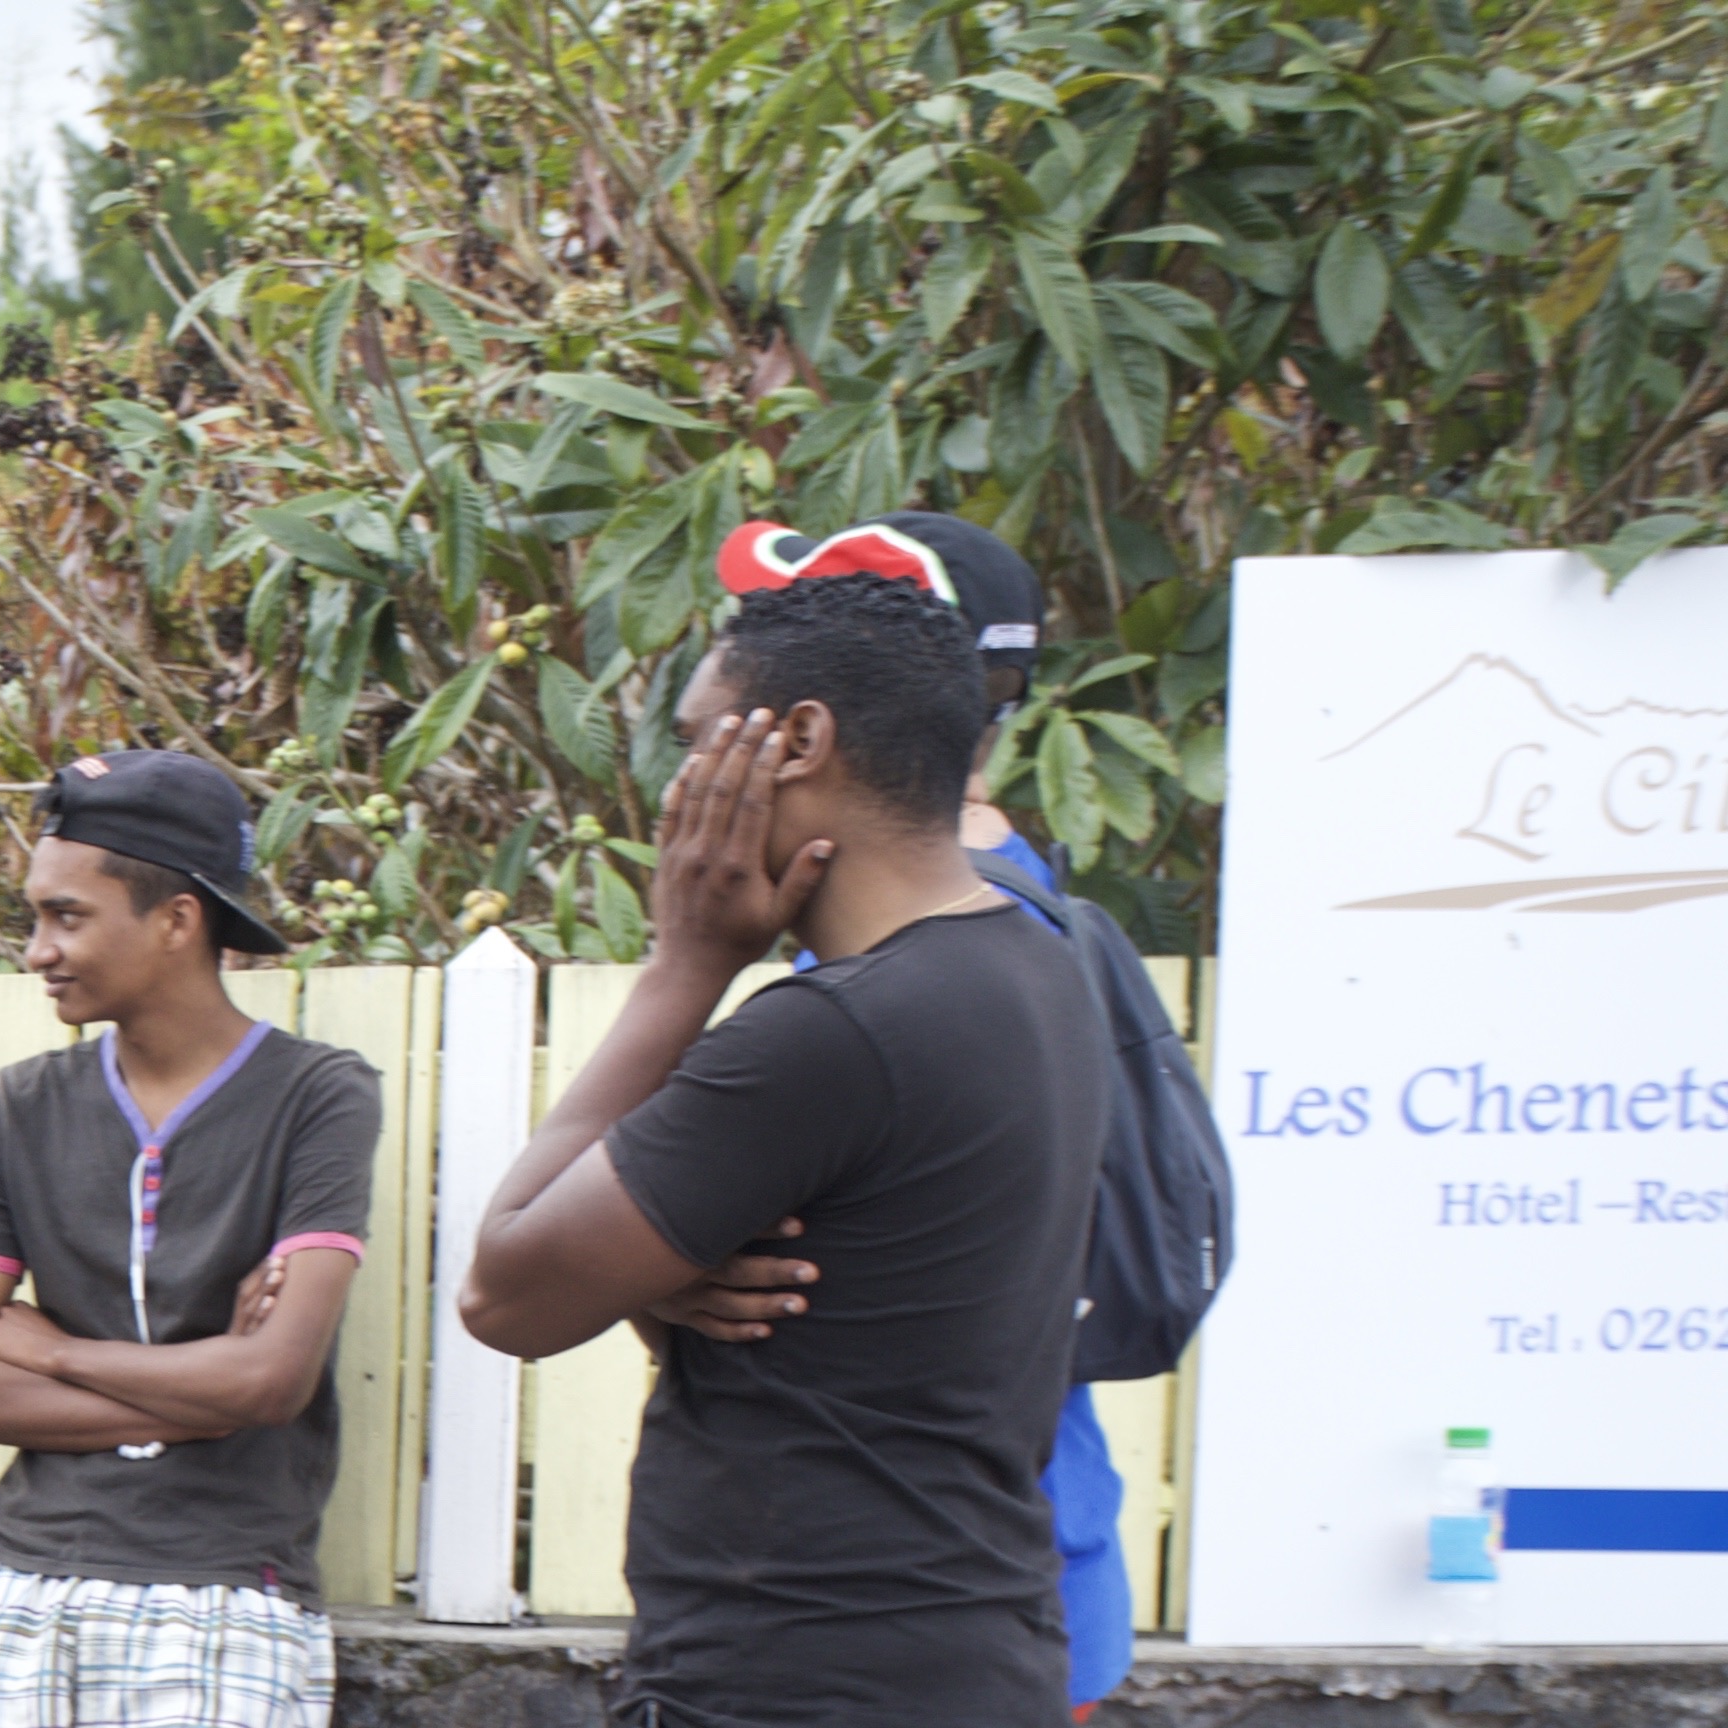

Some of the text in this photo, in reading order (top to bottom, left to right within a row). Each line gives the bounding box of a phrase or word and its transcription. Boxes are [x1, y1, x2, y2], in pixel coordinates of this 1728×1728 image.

[1455, 743, 1555, 864] Le
[1240, 1061, 1728, 1136] Les Chenets
[1437, 1180, 1583, 1226] Hôtel
[1488, 1313, 1560, 1354] Tel
